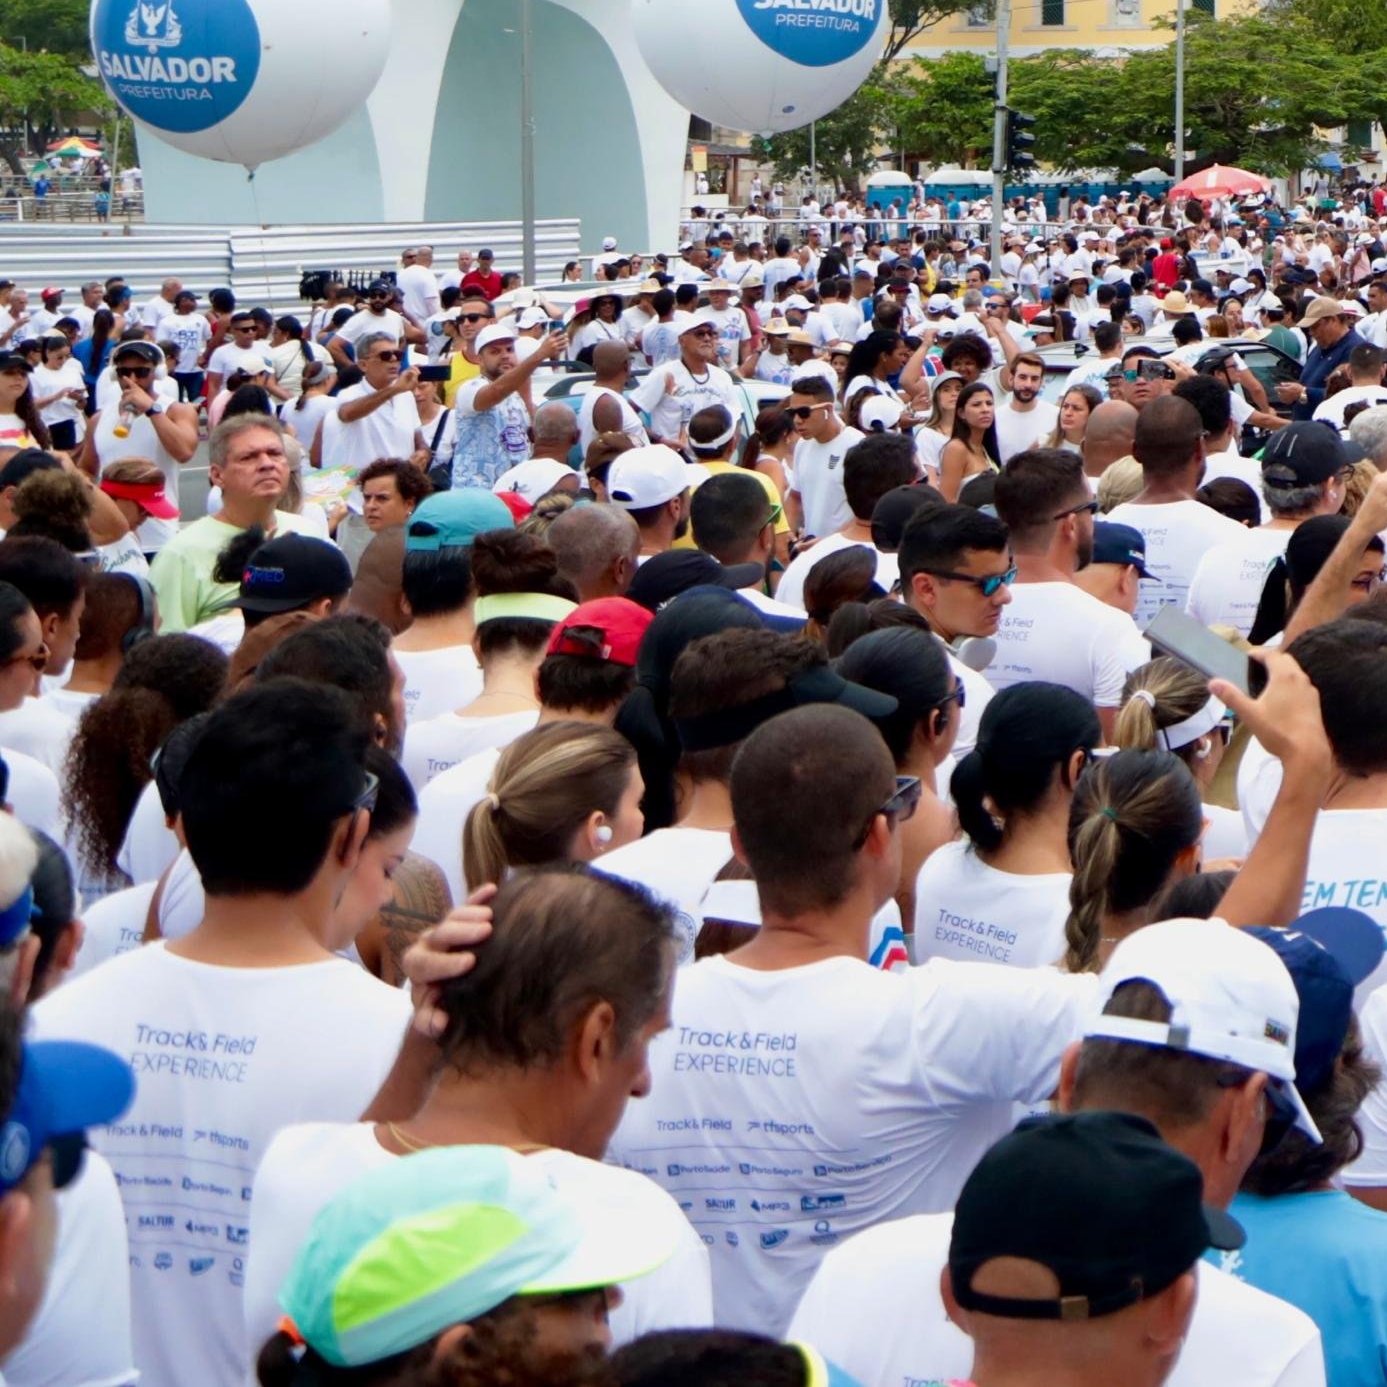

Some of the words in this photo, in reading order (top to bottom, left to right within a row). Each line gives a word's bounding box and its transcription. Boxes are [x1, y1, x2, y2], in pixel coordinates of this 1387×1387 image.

[775, 14, 860, 32] PREFEITURA
[101, 51, 238, 83] SALVADOR
[118, 83, 212, 100] PREFEITURA
[1302, 881, 1336, 908] EM
[939, 908, 977, 932] Track
[986, 924, 1018, 945] Field
[935, 927, 1012, 962] EXPERIENCE
[136, 1024, 199, 1048] Track
[212, 1034, 257, 1055] Field
[678, 1027, 735, 1049] Track
[754, 1033, 797, 1051] Field
[131, 1053, 248, 1083] EXPERIENCE
[673, 1053, 796, 1077] EXPERIENCE
[151, 1125, 183, 1138] Field
[701, 1119, 732, 1131] Field
